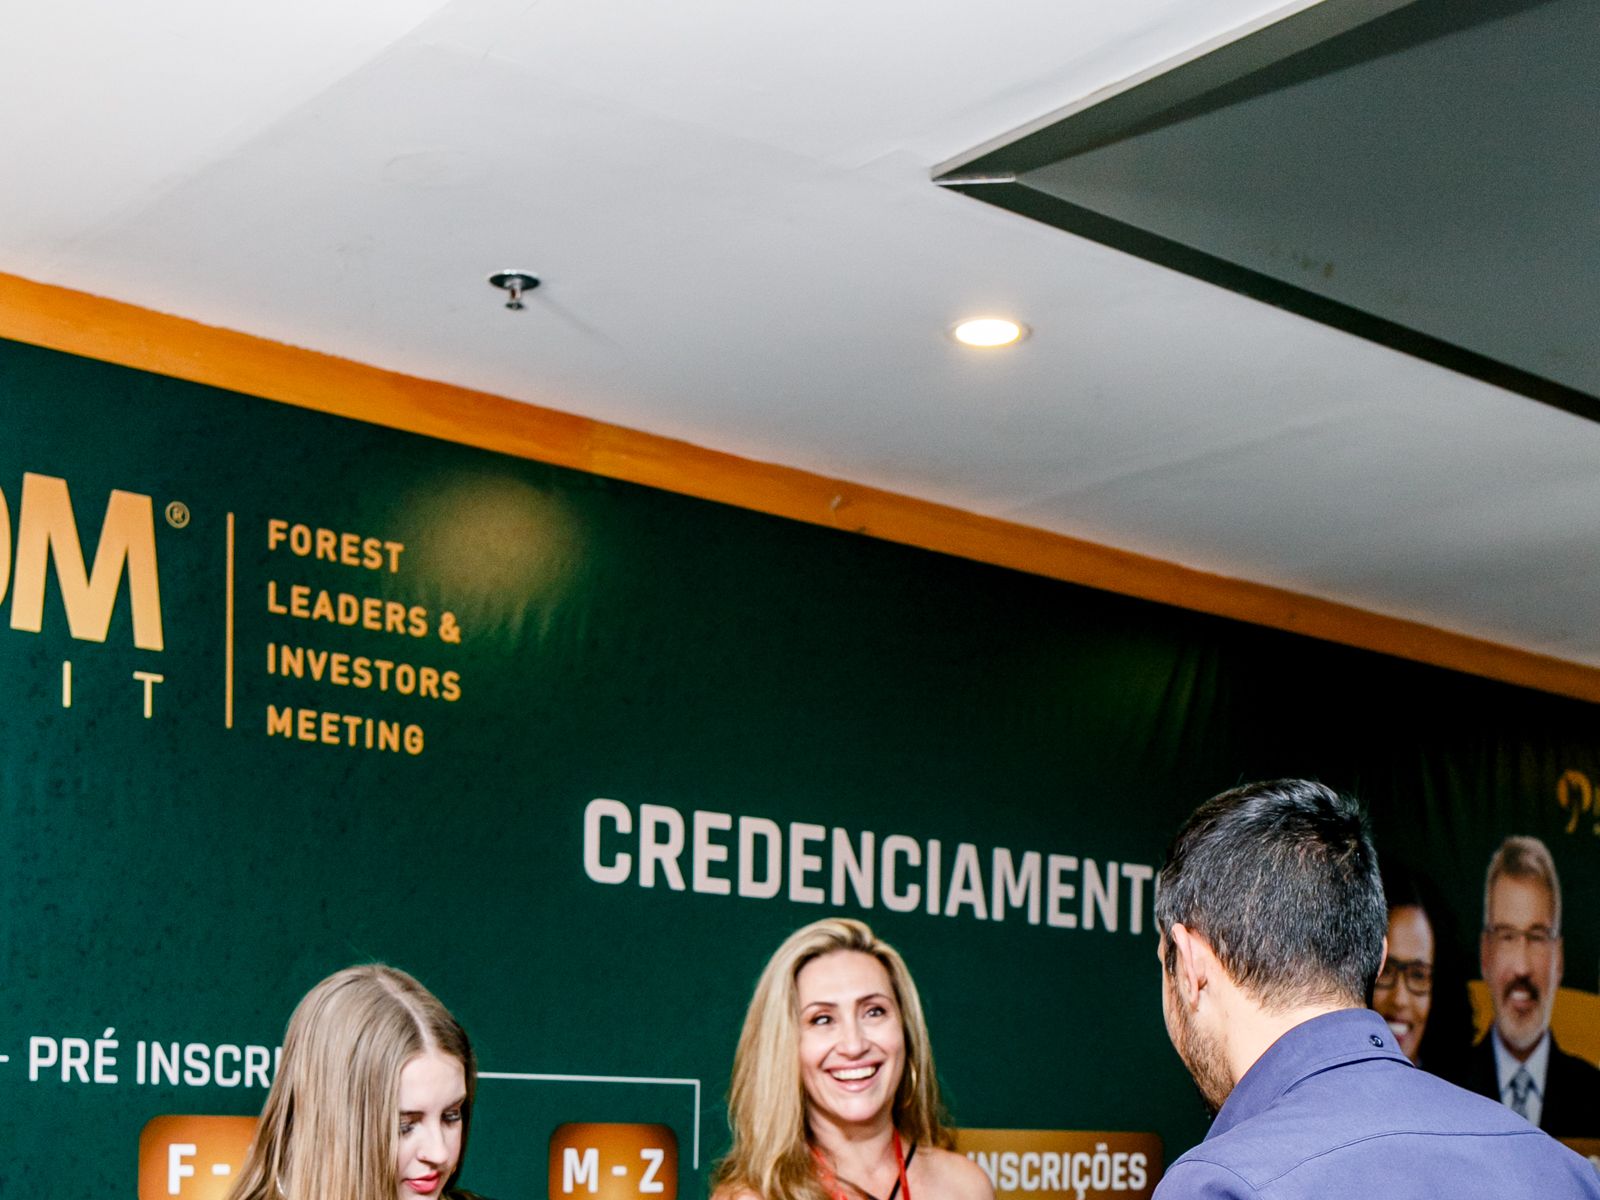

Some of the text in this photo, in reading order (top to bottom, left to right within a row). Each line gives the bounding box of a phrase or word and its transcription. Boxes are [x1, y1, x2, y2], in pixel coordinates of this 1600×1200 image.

[0, 471, 164, 651] M
[268, 518, 404, 574] FOREST
[267, 580, 462, 644] LEADERS &
[266, 642, 462, 702] INVESTORS
[266, 703, 425, 756] MEETING
[583, 798, 1161, 936] CREDENCIAMENT
[28, 1026, 119, 1083] PRÉ
[167, 1142, 197, 1195] F
[562, 1147, 598, 1194] M
[639, 1148, 665, 1193] Z
